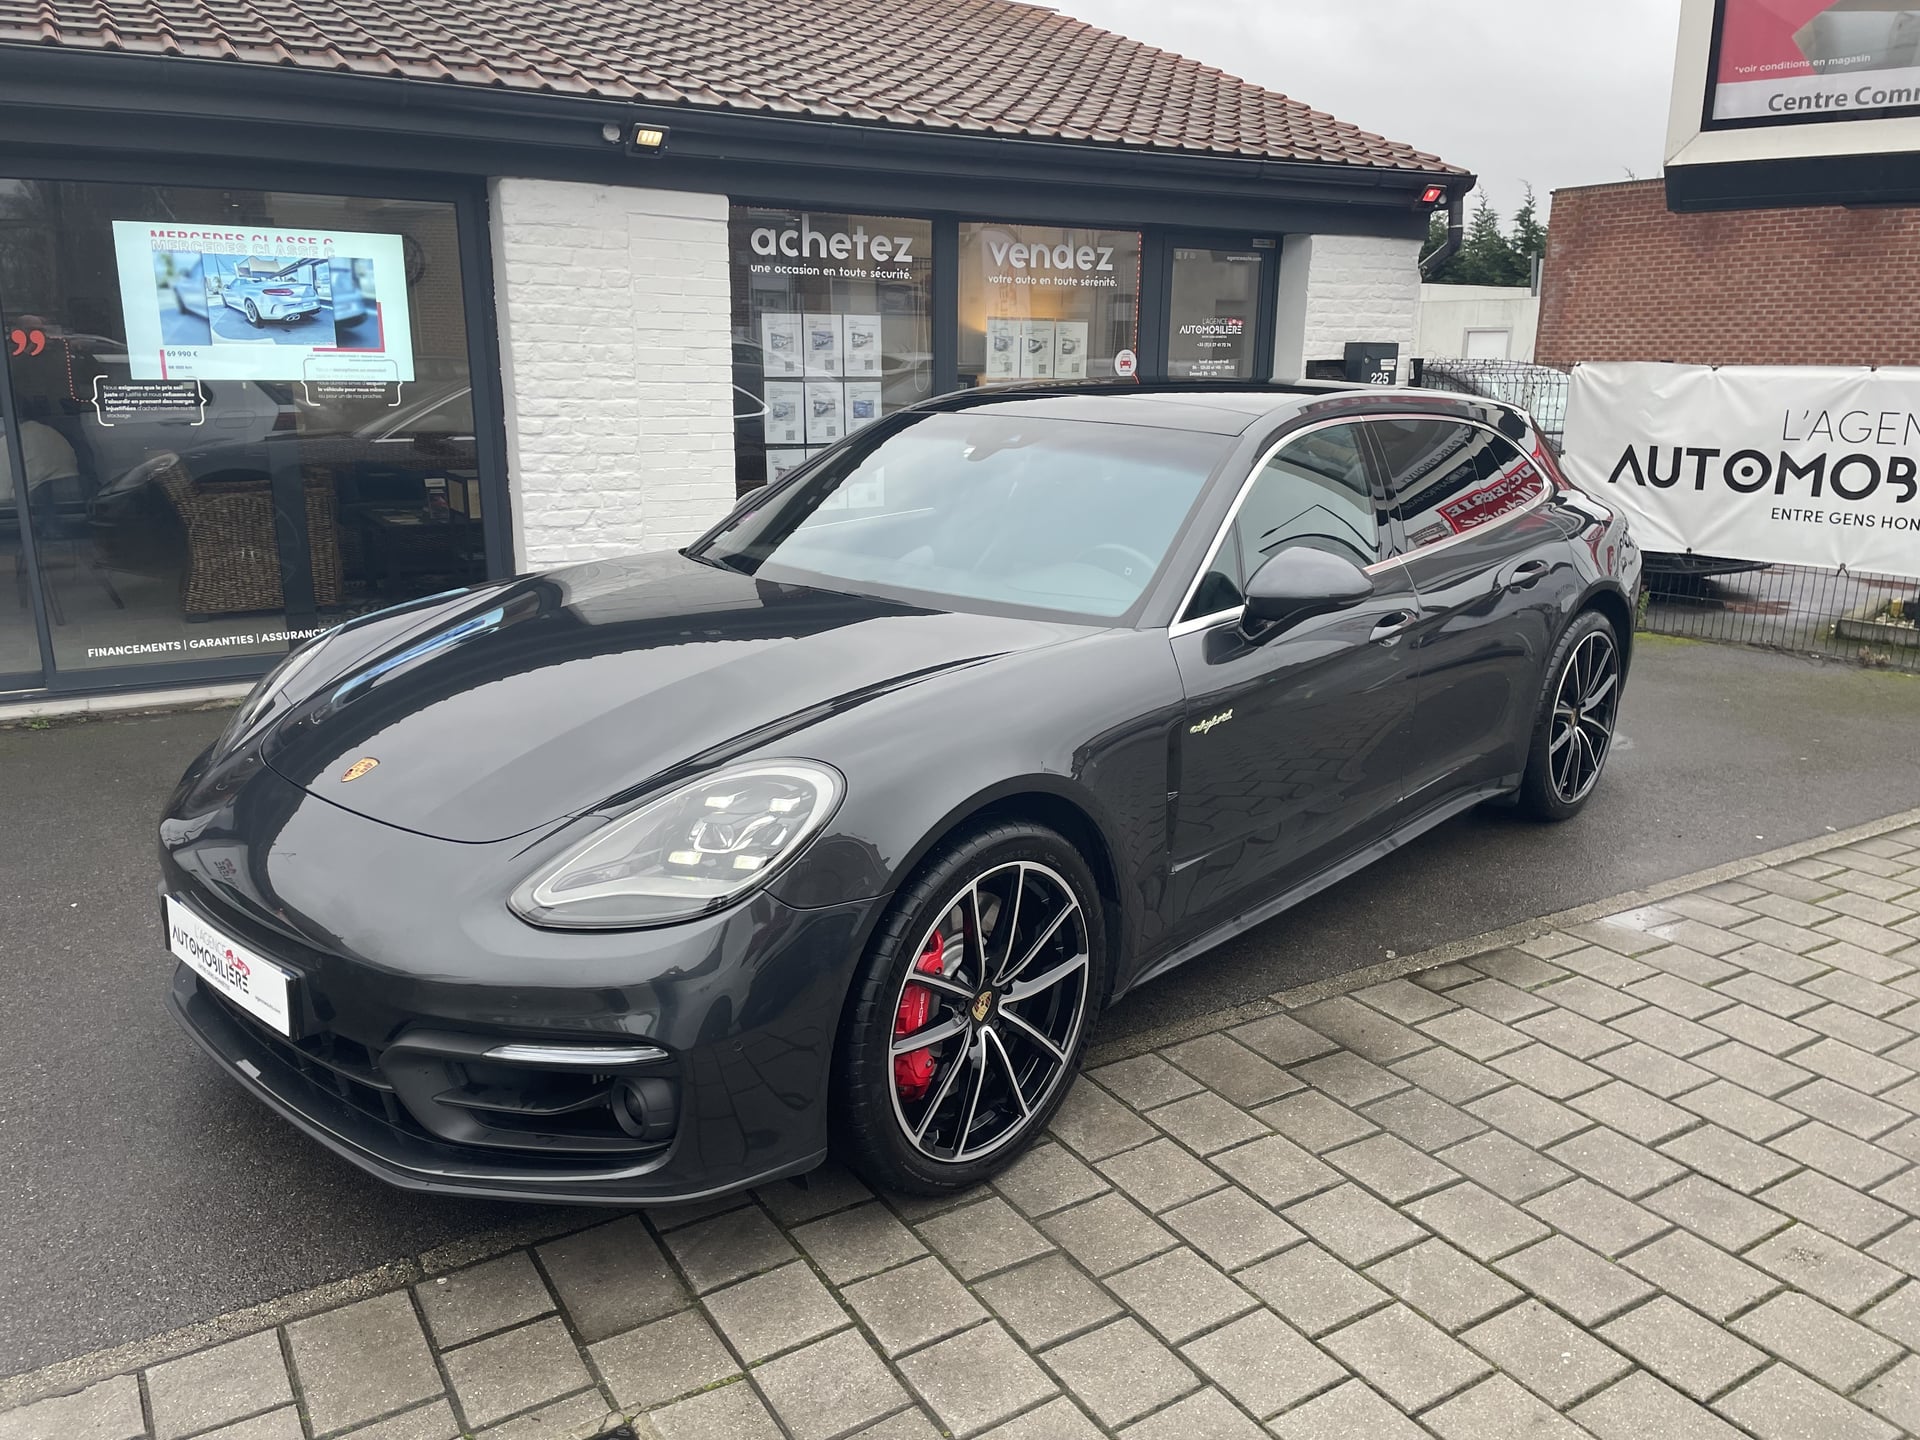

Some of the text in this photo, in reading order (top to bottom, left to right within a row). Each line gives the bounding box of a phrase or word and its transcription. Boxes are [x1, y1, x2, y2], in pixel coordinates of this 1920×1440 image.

[1759, 59, 1810, 72] conditions
[1813, 58, 1826, 66] en
[1828, 54, 1871, 66] magasin
[1768, 91, 1848, 112] Centre
[750, 219, 913, 263] achetez
[988, 235, 1114, 271] vendez
[750, 264, 913, 280] une occasion en toute sécurité.
[988, 274, 1118, 288] votre auto en toute sérénité.
[1370, 372, 1390, 385] 225
[1608, 443, 1918, 504] AUTOMOB
[1771, 507, 1920, 531] ENTRE GENS HON
[87, 641, 181, 658] FINANCEMENTS
[189, 634, 255, 649] GARANTIES
